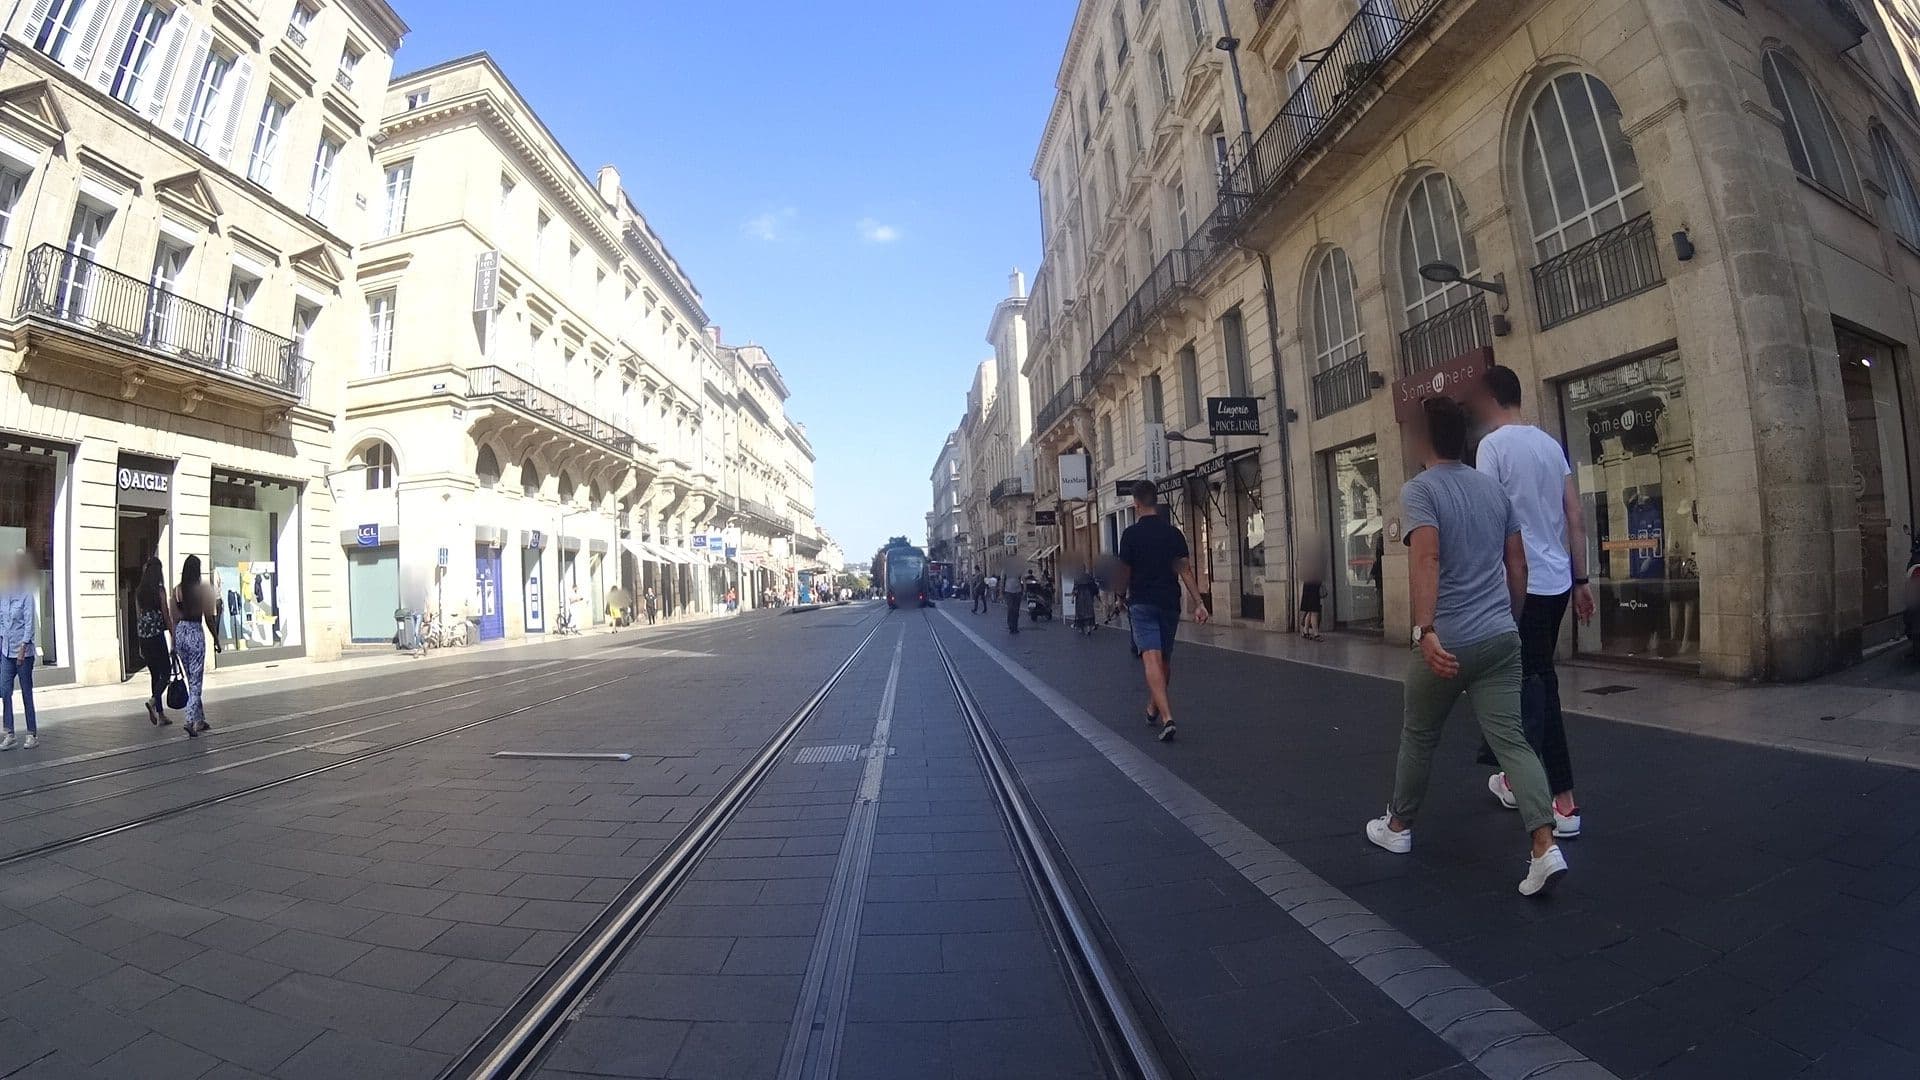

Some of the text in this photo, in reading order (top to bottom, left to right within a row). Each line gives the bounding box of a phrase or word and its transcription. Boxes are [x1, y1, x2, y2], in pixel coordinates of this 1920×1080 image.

[1217, 400, 1250, 418] Lingerie
[1215, 420, 1235, 431] PINCE
[1239, 420, 1259, 431] LINGE
[130, 472, 168, 492] AIGLE
[358, 527, 377, 537] LCL
